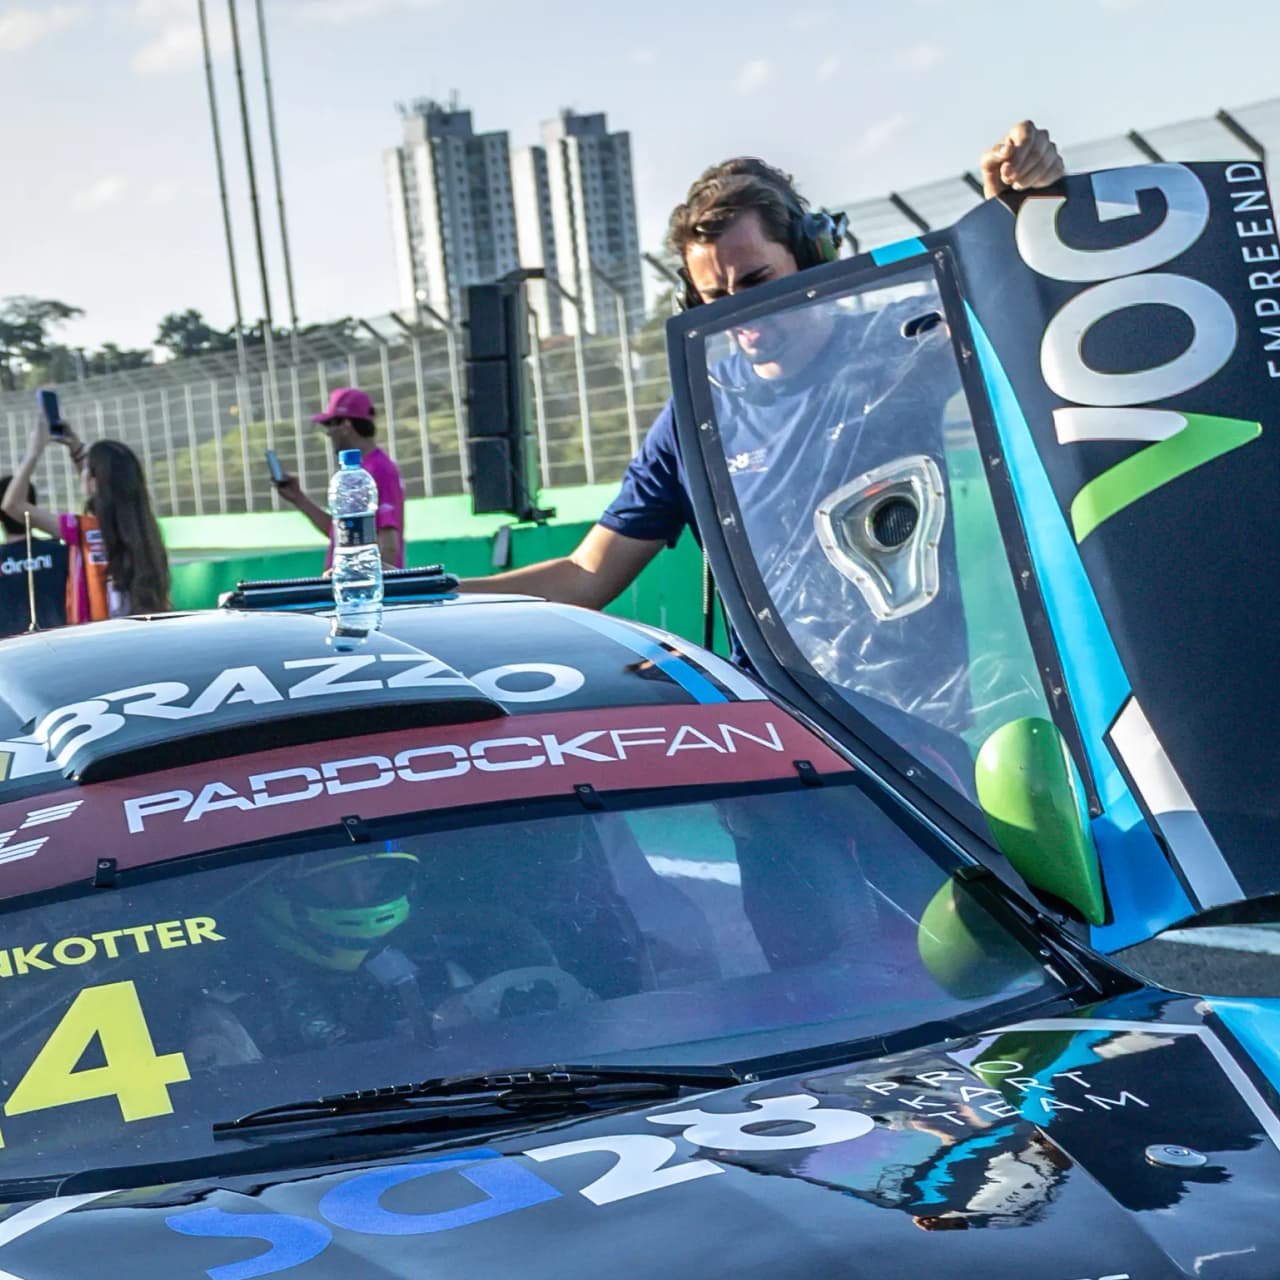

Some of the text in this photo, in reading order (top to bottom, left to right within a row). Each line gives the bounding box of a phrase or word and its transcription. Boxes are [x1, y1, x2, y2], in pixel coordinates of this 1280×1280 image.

[1014, 162, 1263, 545] VOG
[123, 722, 786, 834] PADDOCKFAN
[927, 1090, 1150, 1126] TEAM
